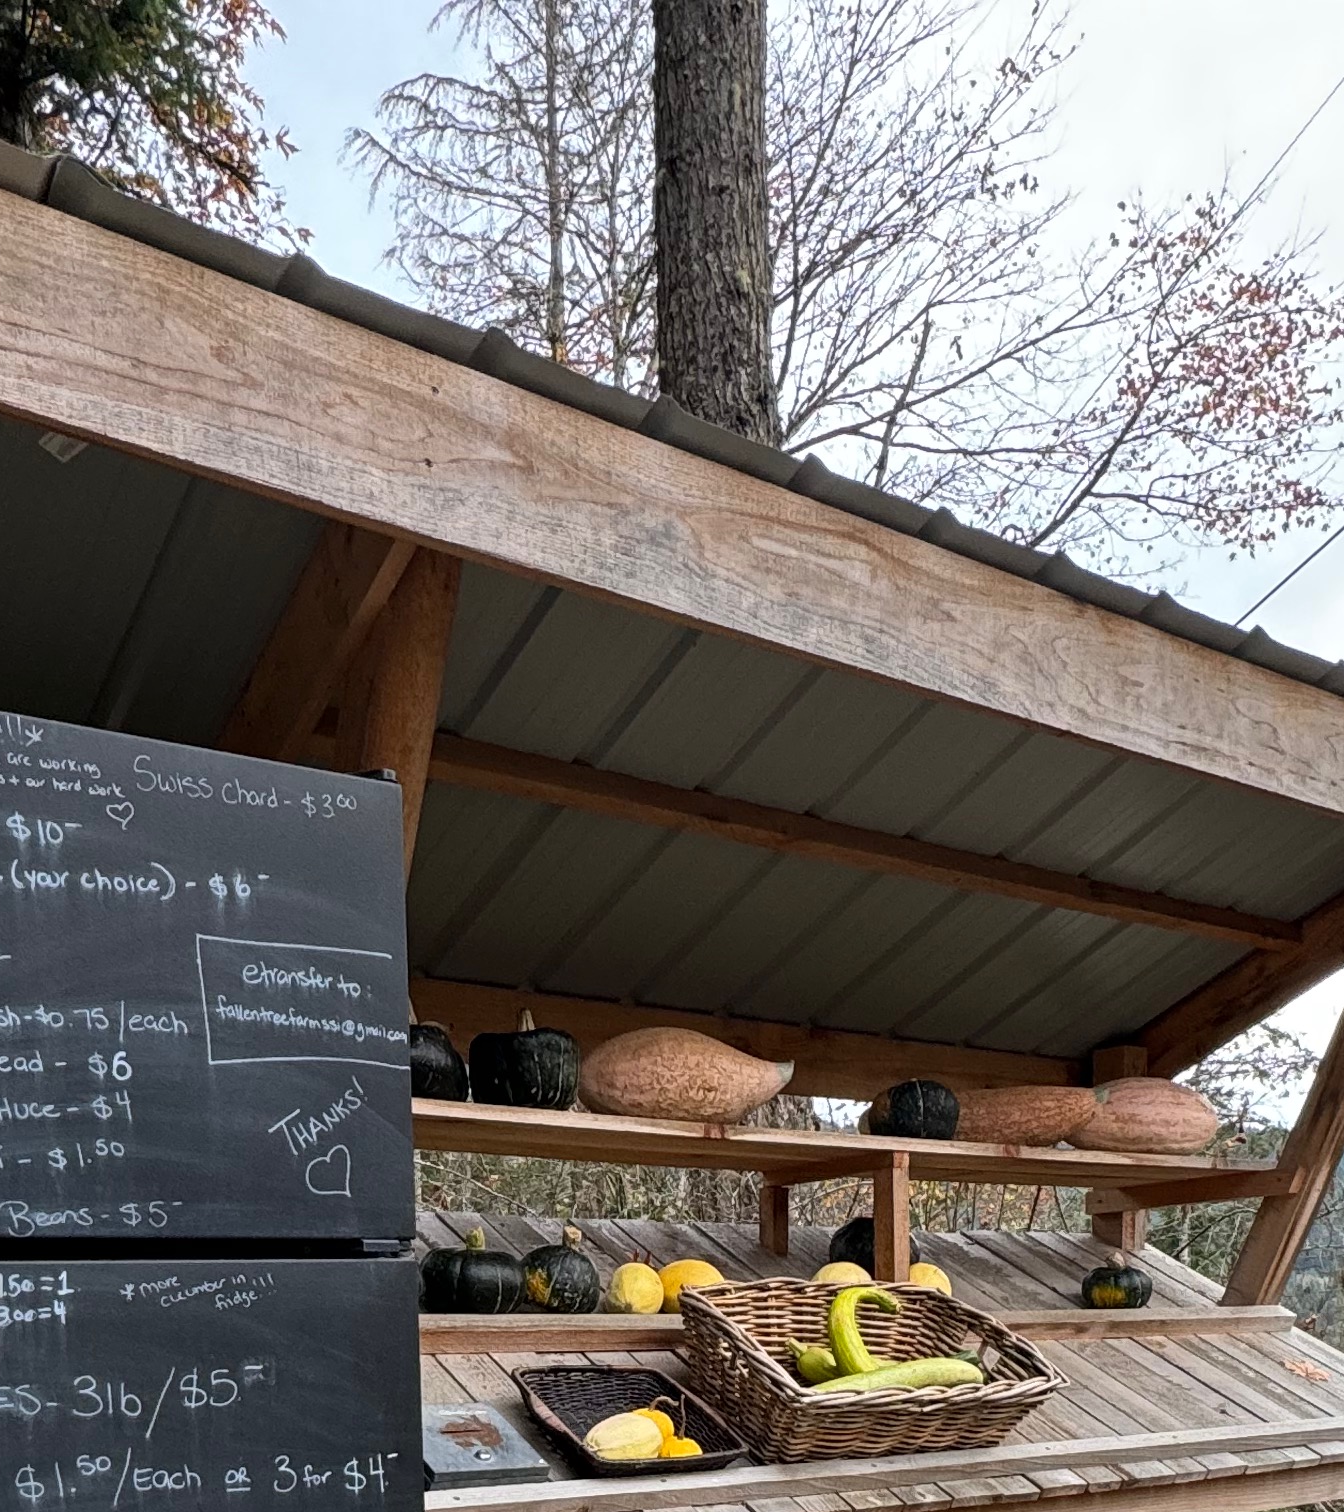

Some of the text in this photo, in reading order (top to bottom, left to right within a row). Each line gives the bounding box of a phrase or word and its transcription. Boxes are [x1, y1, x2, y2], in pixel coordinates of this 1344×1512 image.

[7, 751, 33, 767] are
[39, 755, 101, 778] working
[133, 755, 213, 799] Swiss
[26, 778, 46, 788] our
[52, 777, 82, 792] hard
[88, 784, 126, 798] work
[10, 858, 69, 891] (your
[80, 860, 177, 901] choice)
[242, 960, 334, 989] etransfer
[87, 1050, 133, 1081] $6
[90, 1090, 133, 1123] $4
[267, 1075, 368, 1156] THANKS!
[160, 1274, 247, 1308] cucumber in
[274, 1454, 297, 1493] 3
[302, 1466, 333, 1488] for
